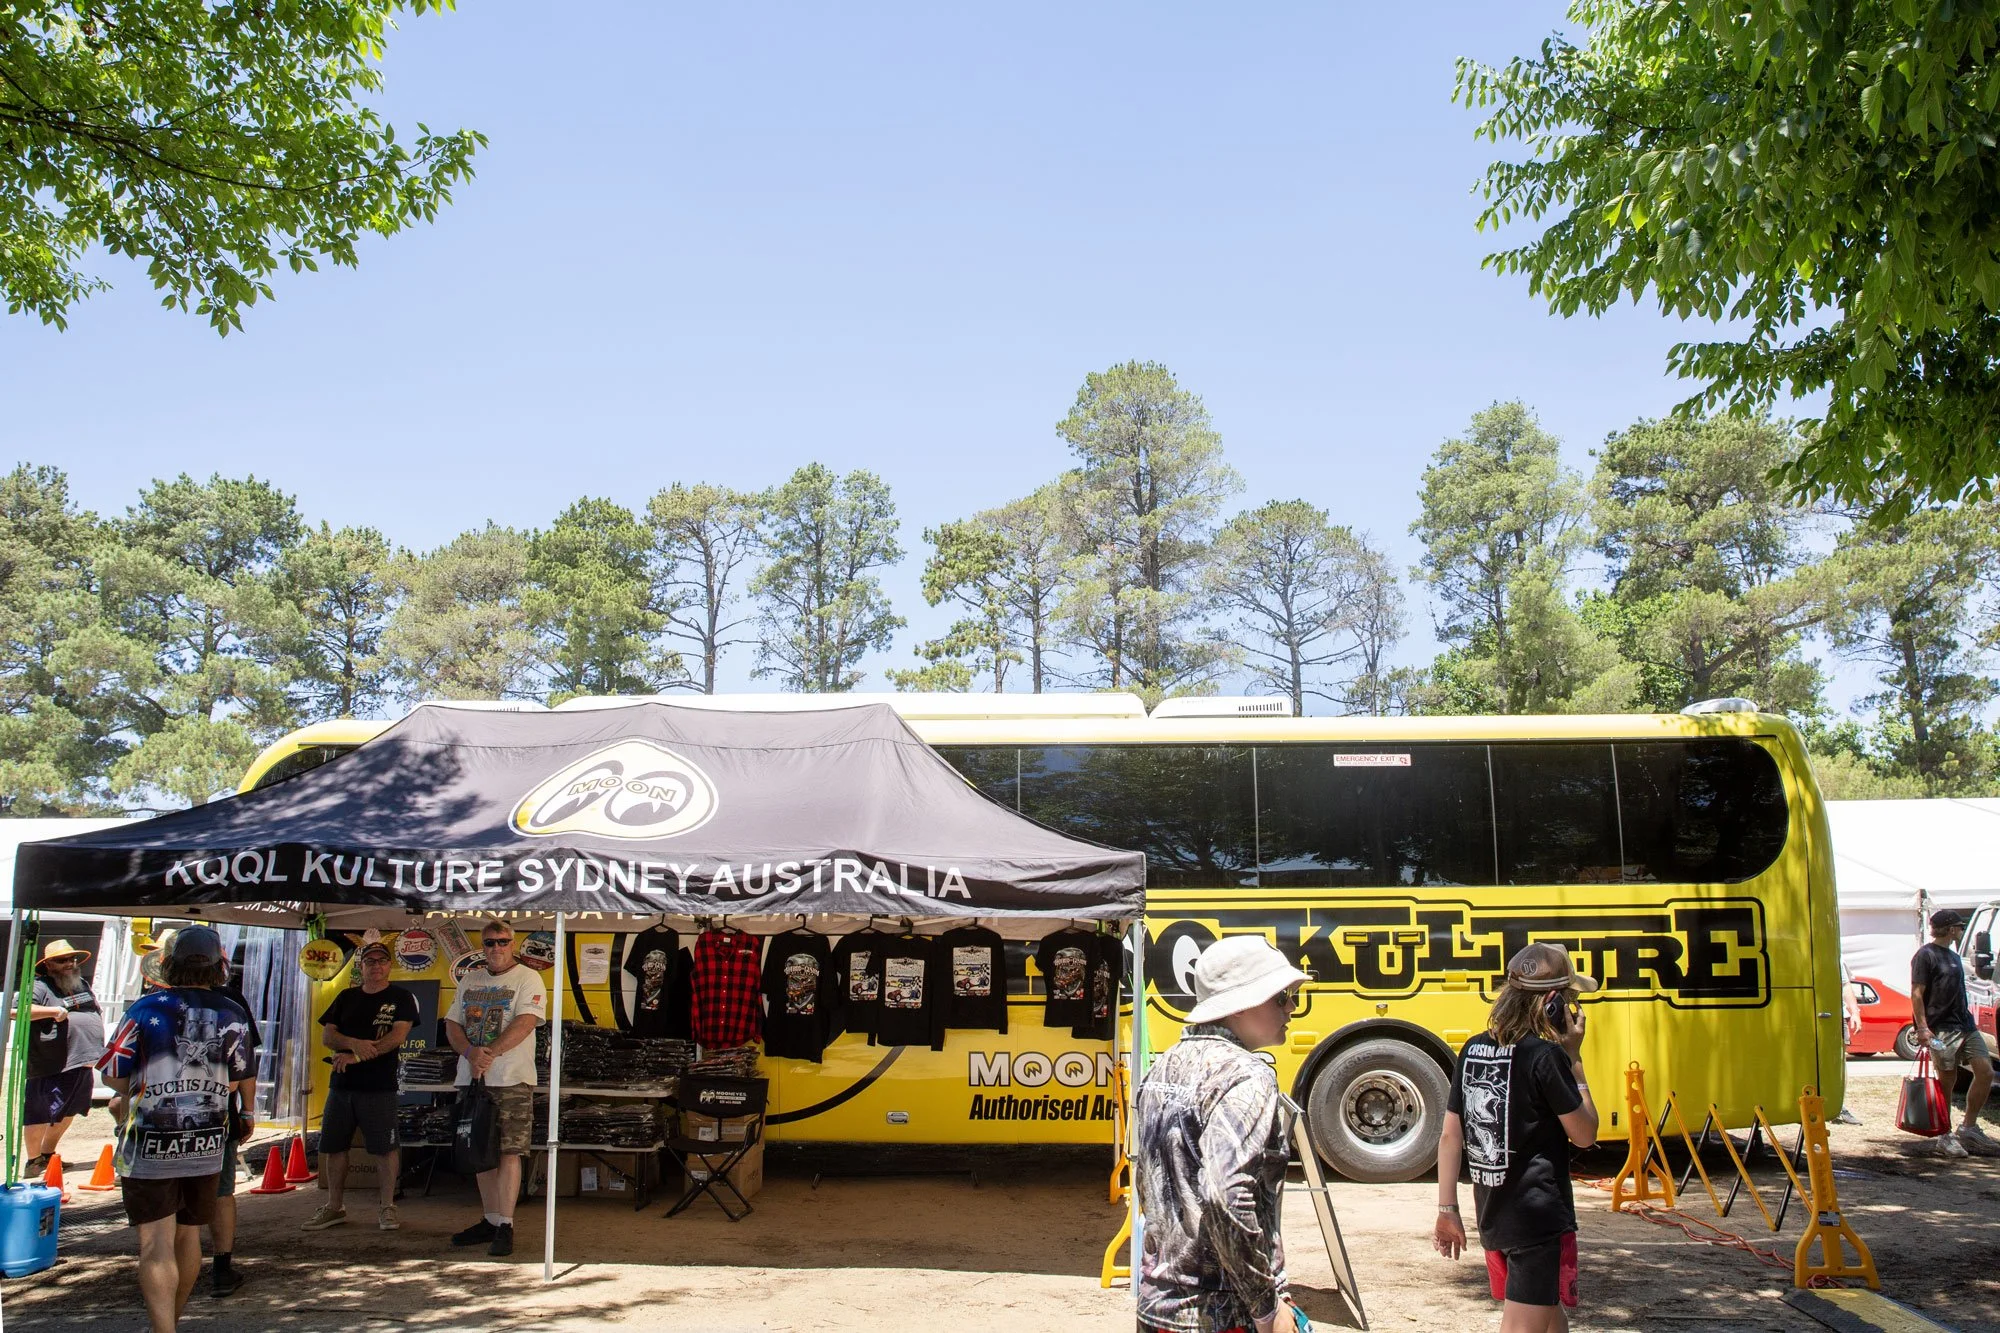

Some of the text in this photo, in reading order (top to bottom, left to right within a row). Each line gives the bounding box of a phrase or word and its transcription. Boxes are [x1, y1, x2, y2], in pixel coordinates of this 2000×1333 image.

[568, 775, 676, 803] MOON
[301, 850, 505, 893] KULTURE
[517, 858, 700, 895] SYDNEY
[707, 858, 972, 899] AUSTRALIA
[409, 1039, 426, 1049] FOR
[143, 1080, 186, 1099] SUCH
[186, 1078, 201, 1091] IS
[968, 1094, 1085, 1121] Authorised
[145, 1134, 222, 1154] FLAT RAT
